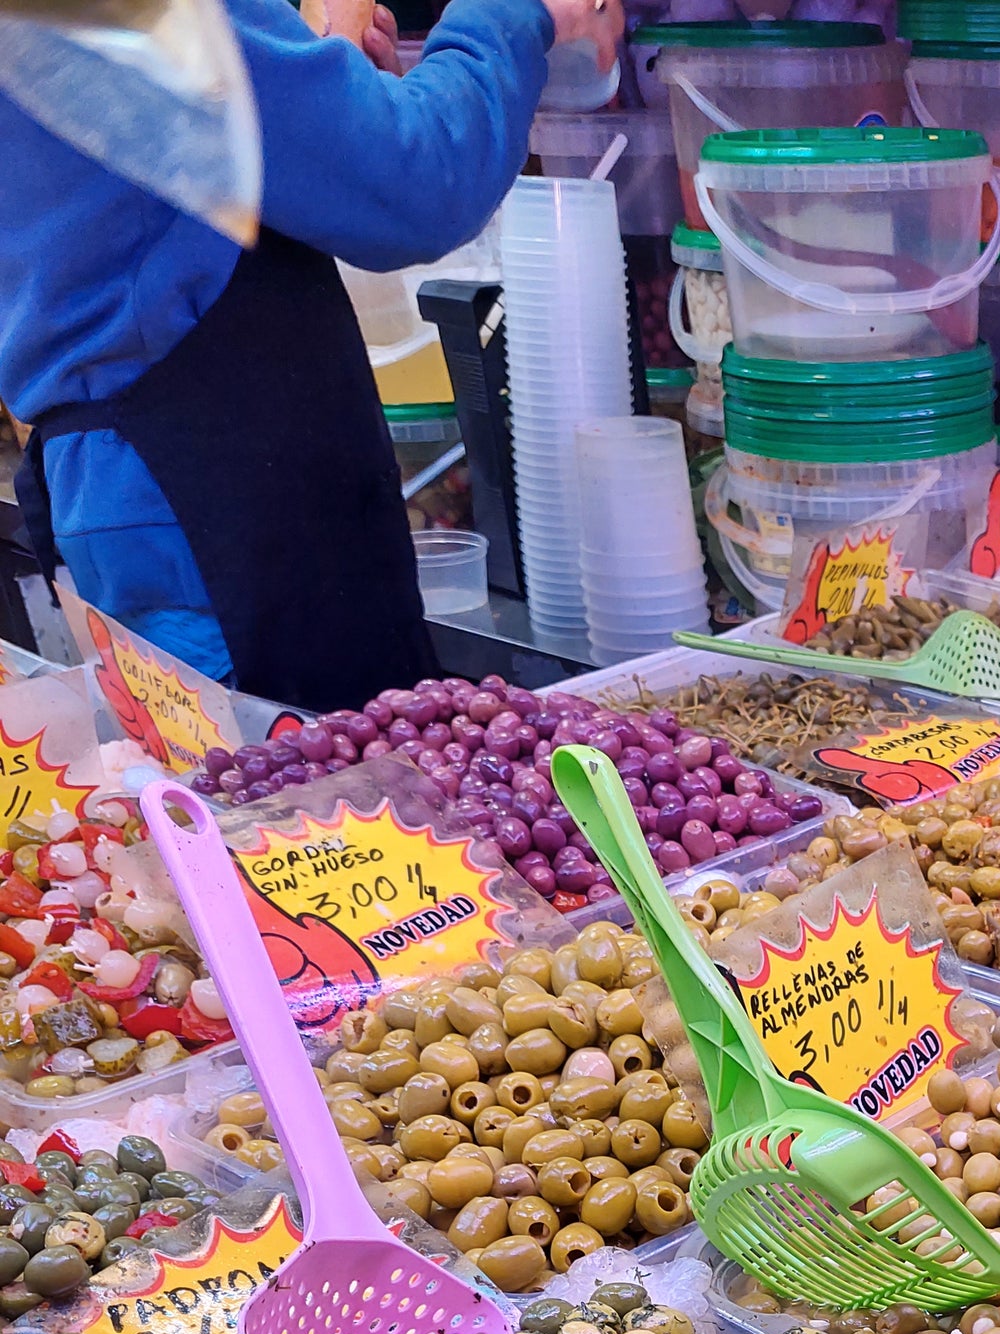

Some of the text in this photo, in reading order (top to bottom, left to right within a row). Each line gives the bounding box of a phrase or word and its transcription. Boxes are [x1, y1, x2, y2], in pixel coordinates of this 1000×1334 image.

[825, 562, 889, 583] PEPINILLOS
[122, 659, 197, 713] COLIFLOR
[915, 735, 969, 760] 2,00
[252, 838, 356, 876] GORDAL
[260, 848, 384, 896] SIN HUESO
[306, 875, 398, 920] 3,00
[364, 896, 476, 957] NOVEDAD
[750, 941, 865, 1020] RELLENAS DE
[761, 964, 870, 1039] ALMENDRAS
[794, 979, 908, 1072] 3,00 1/4
